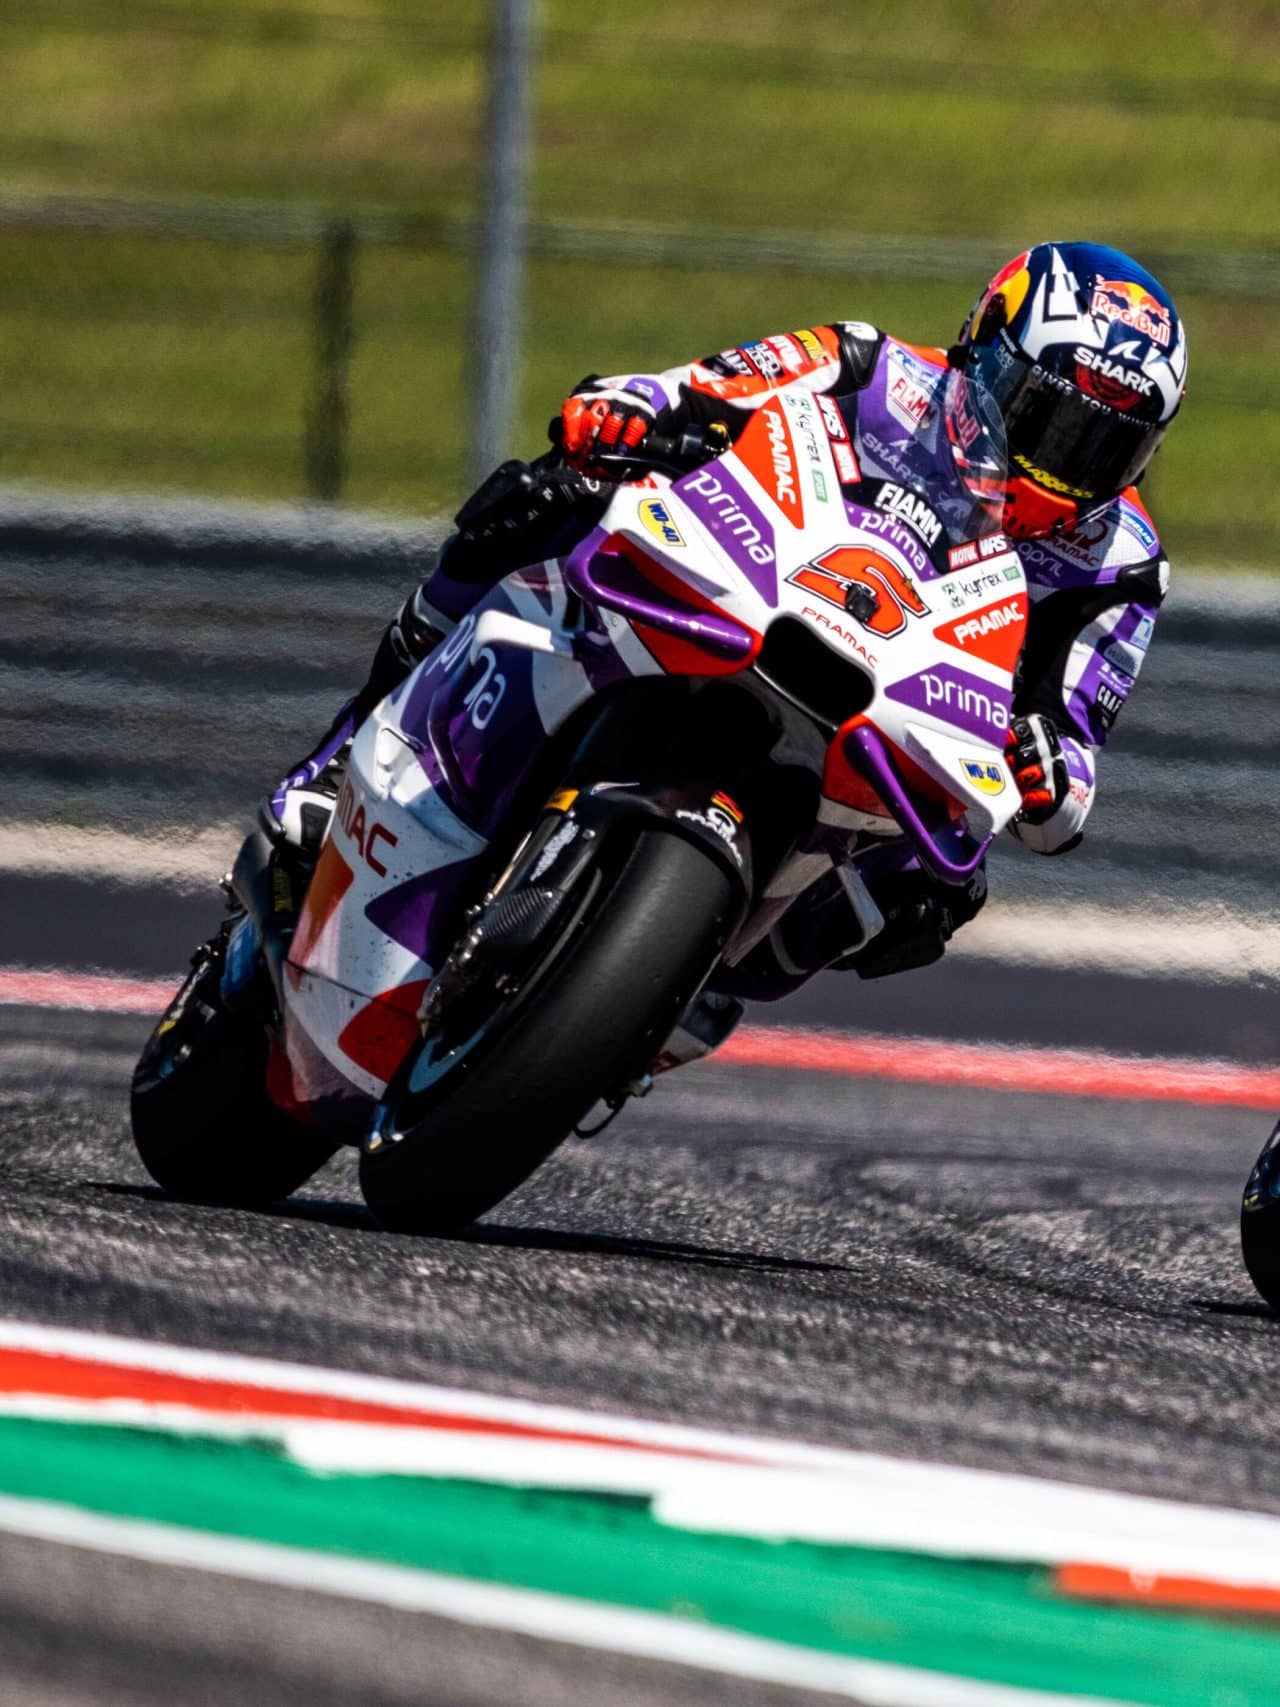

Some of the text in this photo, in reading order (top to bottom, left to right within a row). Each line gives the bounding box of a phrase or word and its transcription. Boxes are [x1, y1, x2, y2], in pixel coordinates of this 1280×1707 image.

[1092, 291, 1171, 346] Red Bull
[1032, 364, 1074, 397] GIVES
[1080, 394, 1113, 416] YOU
[1073, 346, 1155, 397] SHARK
[761, 408, 797, 505] PRAMAC
[647, 502, 681, 543] WD-40
[683, 470, 775, 565] prima
[877, 482, 943, 540] FIAMM
[860, 510, 925, 570] prima
[979, 533, 1009, 556] WRS
[801, 606, 878, 670] PRAMAC
[953, 602, 1025, 645] PRAMAC
[919, 674, 1009, 729] prima
[965, 761, 1001, 782] WD-40
